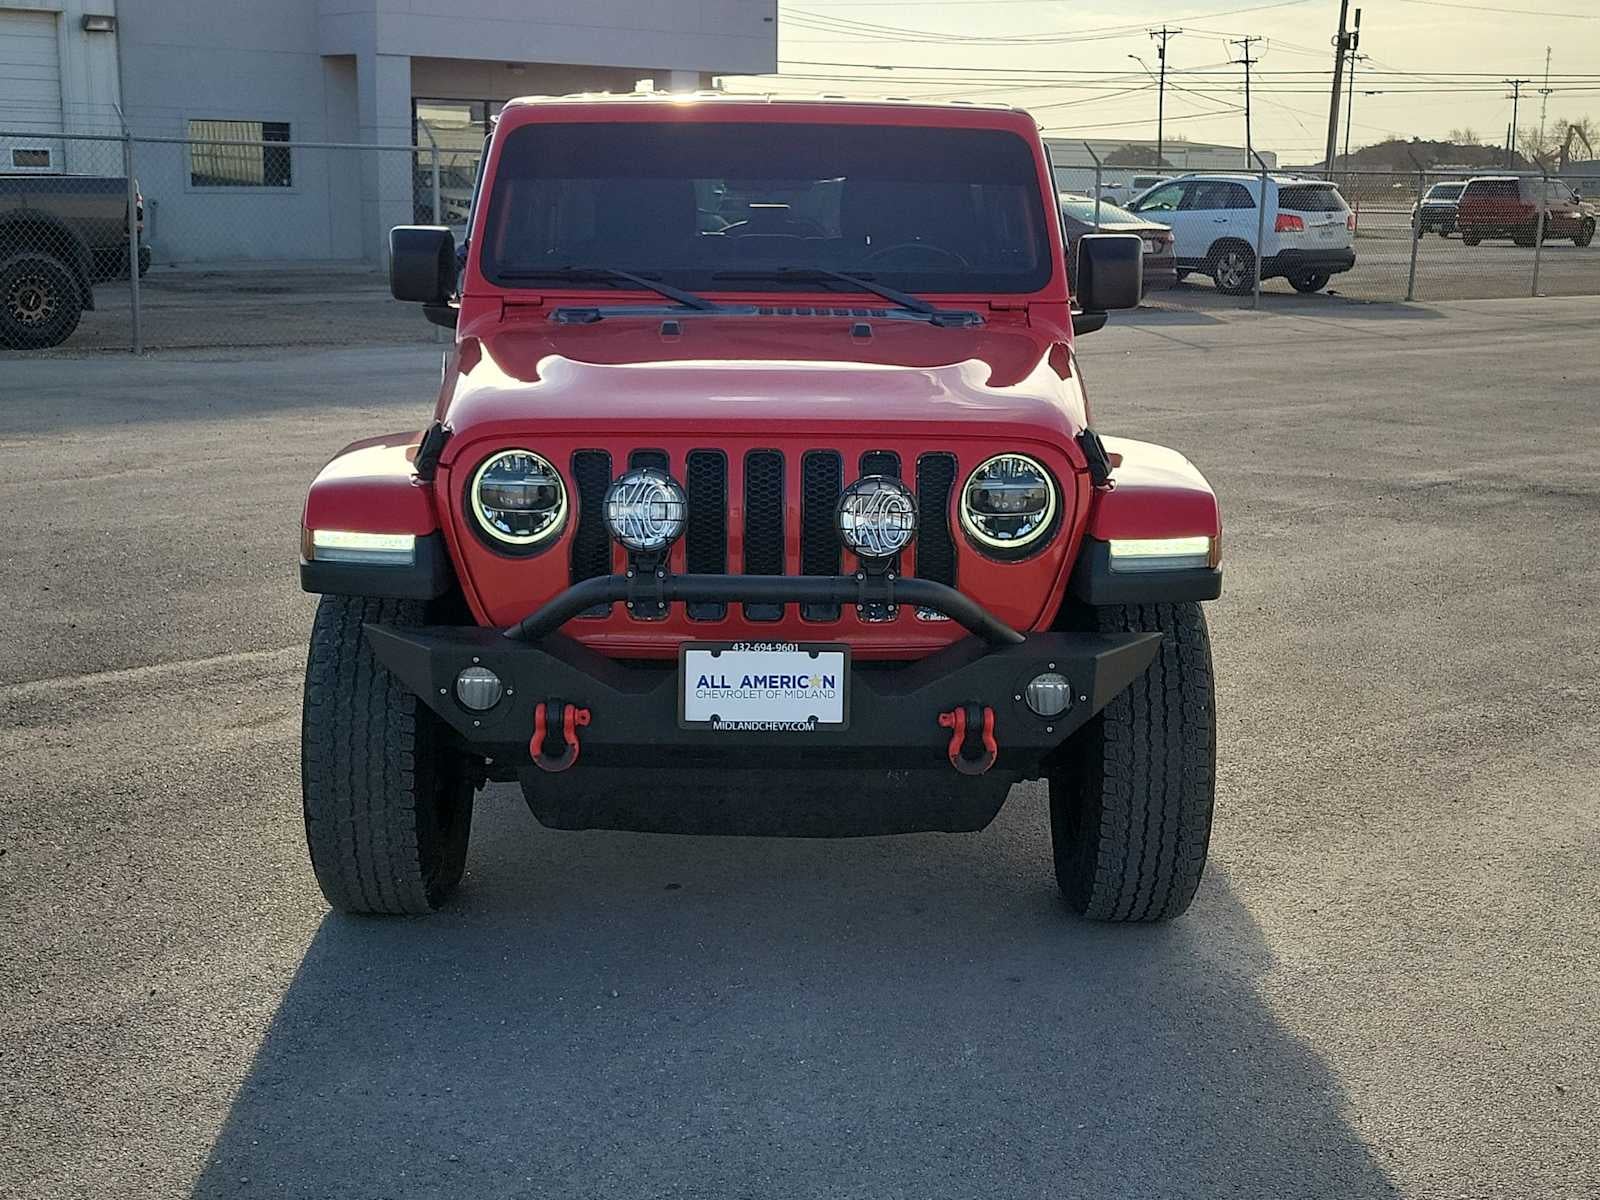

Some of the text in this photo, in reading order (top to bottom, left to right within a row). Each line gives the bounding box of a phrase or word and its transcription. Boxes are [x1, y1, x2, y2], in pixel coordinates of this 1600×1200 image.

[615, 478, 671, 543] KC
[853, 490, 909, 553] KC
[732, 642, 799, 652] 432-694-9601
[696, 675, 731, 689] ALL
[696, 689, 836, 699] CHEVROLET OF MIDLAND
[713, 720, 815, 731] MIDLANDCHEVY.COM
